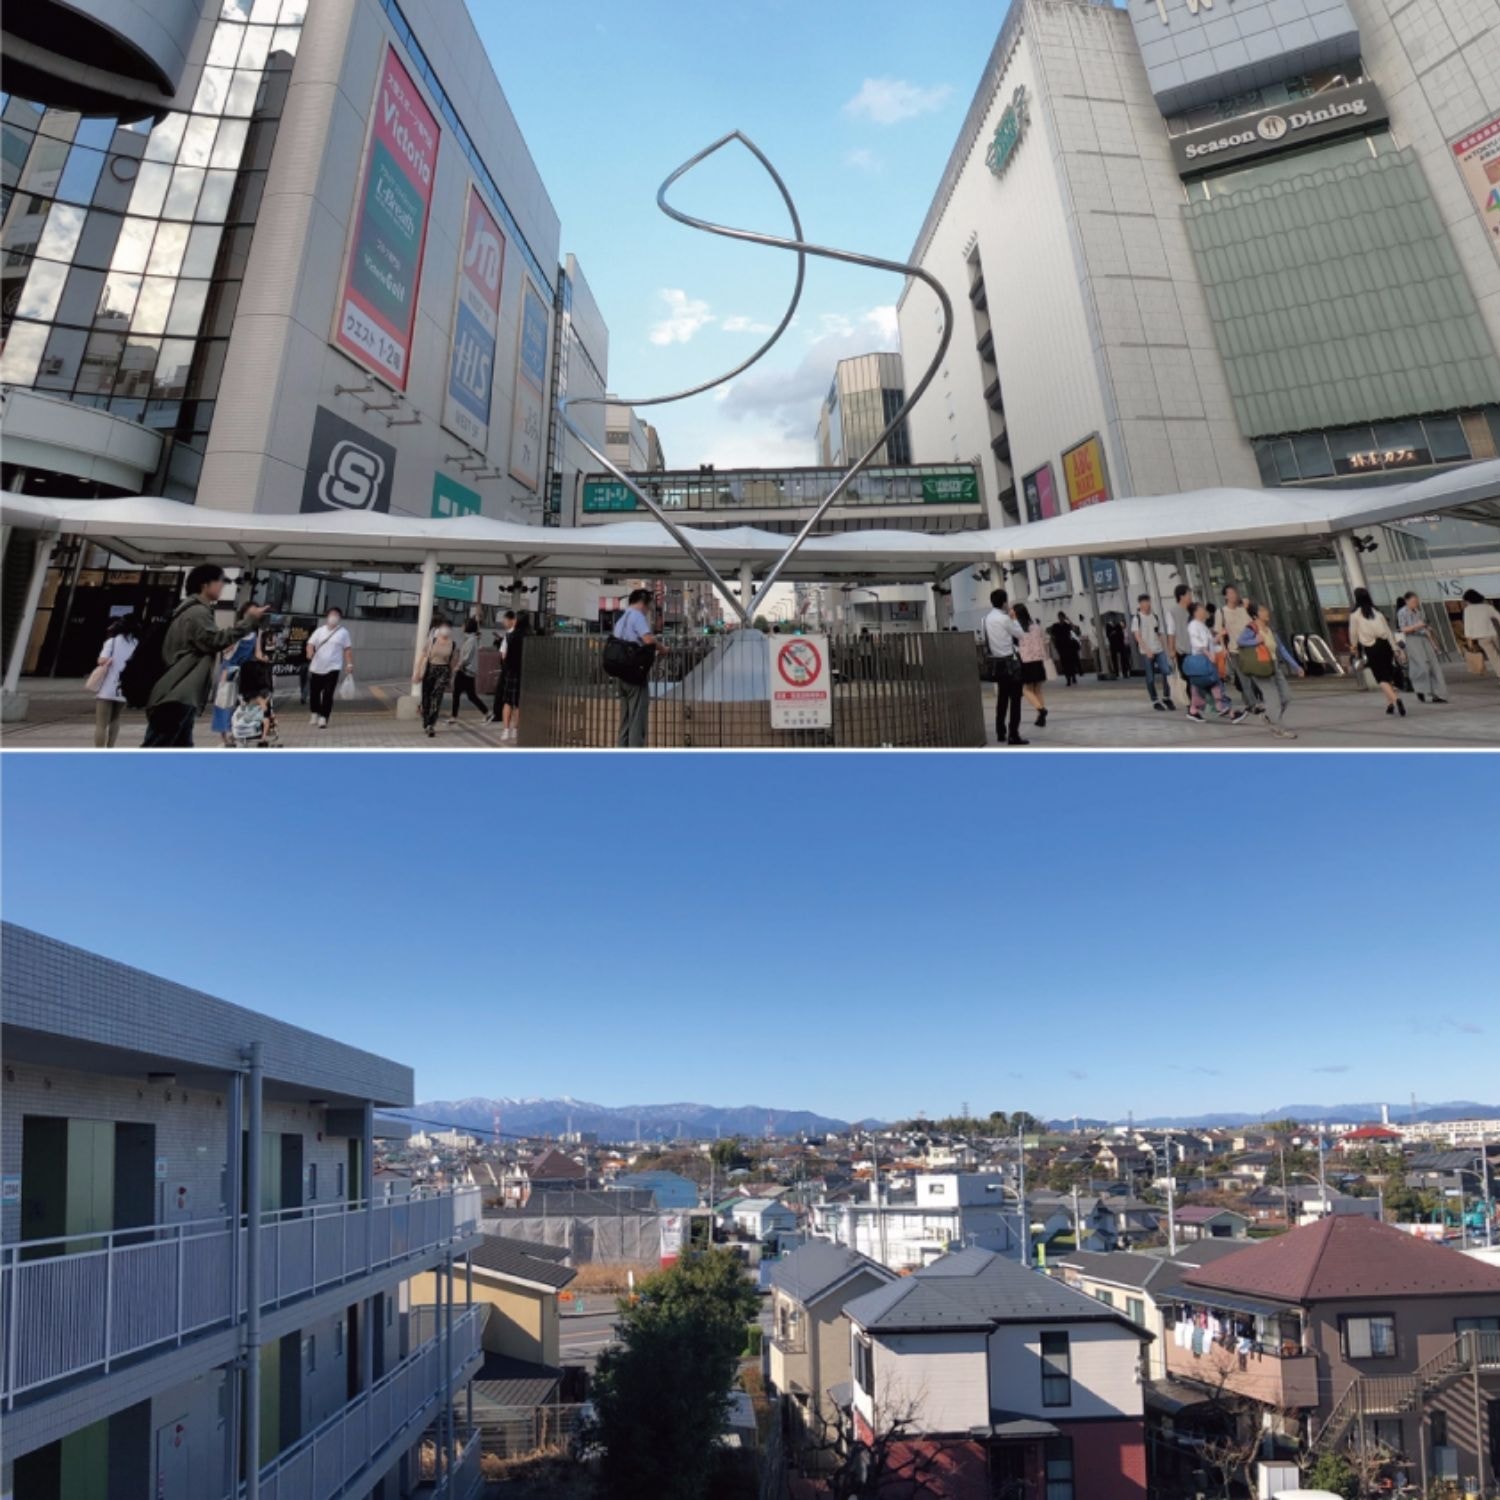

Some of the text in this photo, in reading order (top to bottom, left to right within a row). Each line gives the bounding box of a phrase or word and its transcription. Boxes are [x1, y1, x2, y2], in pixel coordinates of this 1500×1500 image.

[383, 89, 430, 186] Victoria
[1185, 129, 1257, 159] Season
[1288, 98, 1368, 130] Dining
[463, 213, 500, 292] JTB
